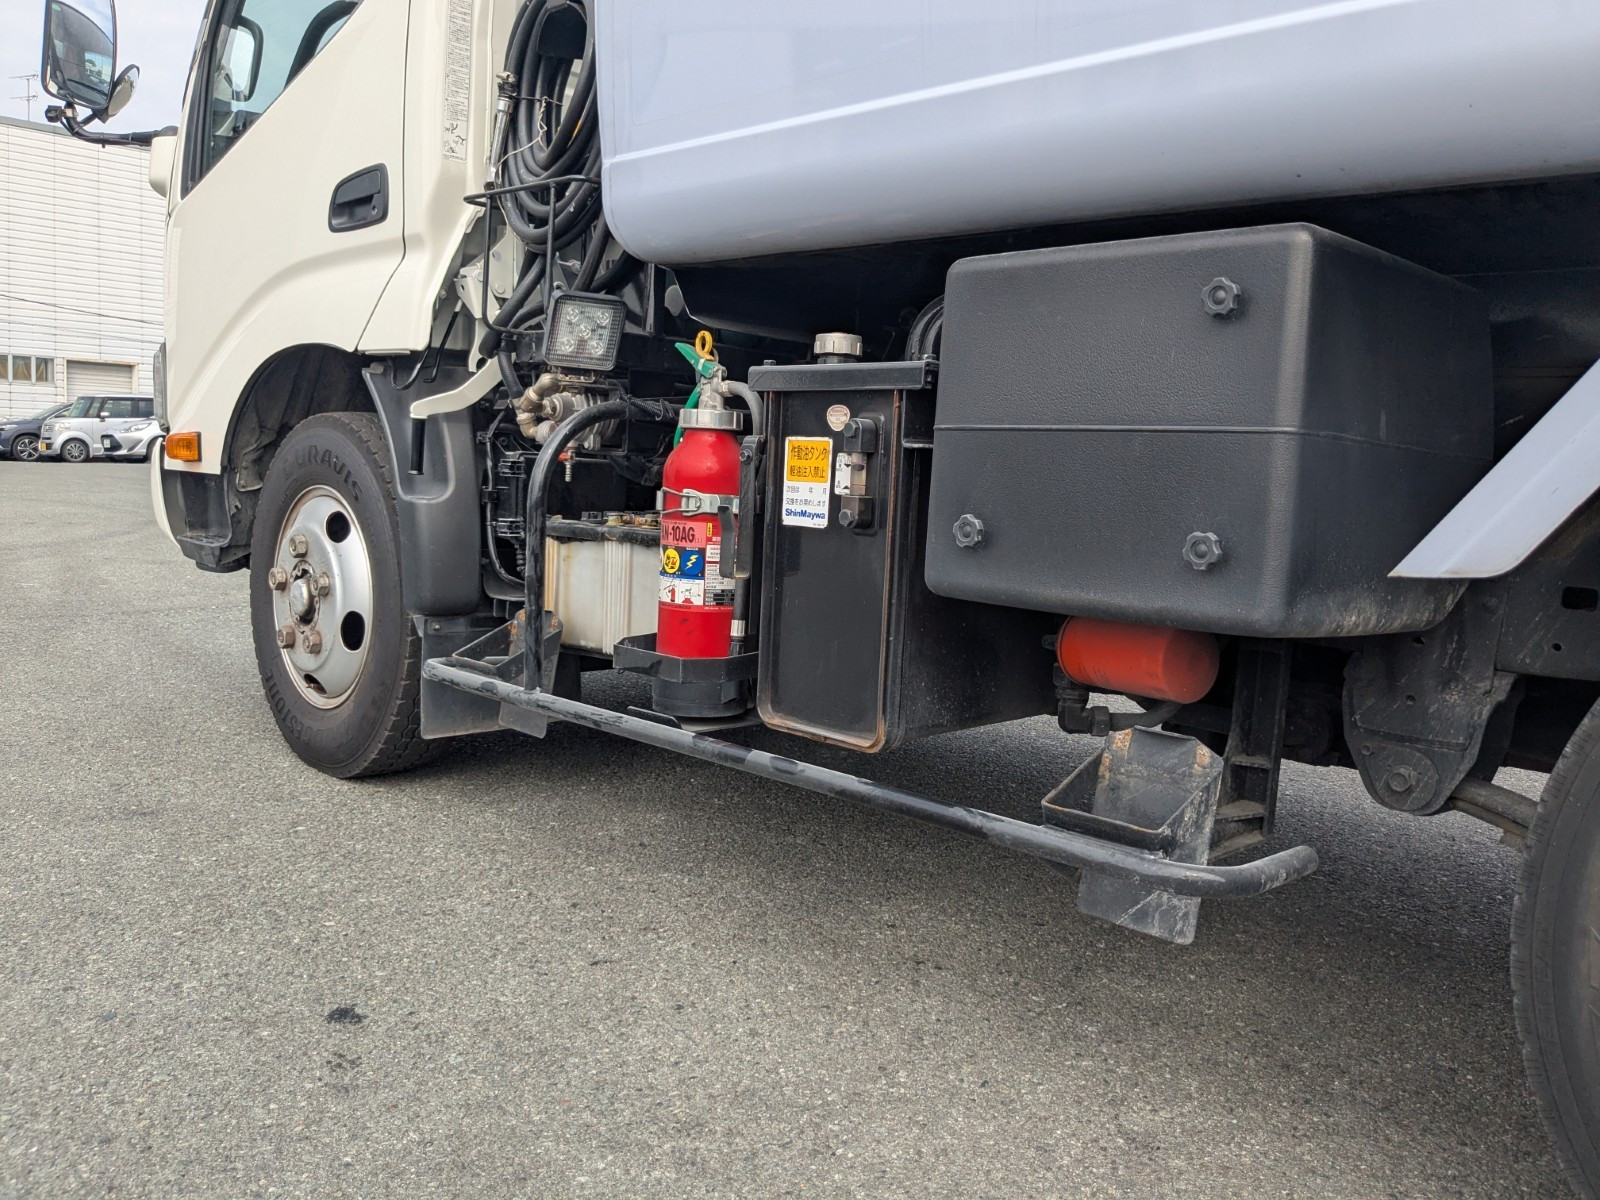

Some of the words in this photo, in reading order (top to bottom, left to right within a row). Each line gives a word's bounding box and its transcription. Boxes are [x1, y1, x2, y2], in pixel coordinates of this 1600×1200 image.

[790, 444, 828, 461] 作動油タンク
[789, 465, 826, 479] 軽油注入禁止
[785, 508, 826, 520] ShinMaywa
